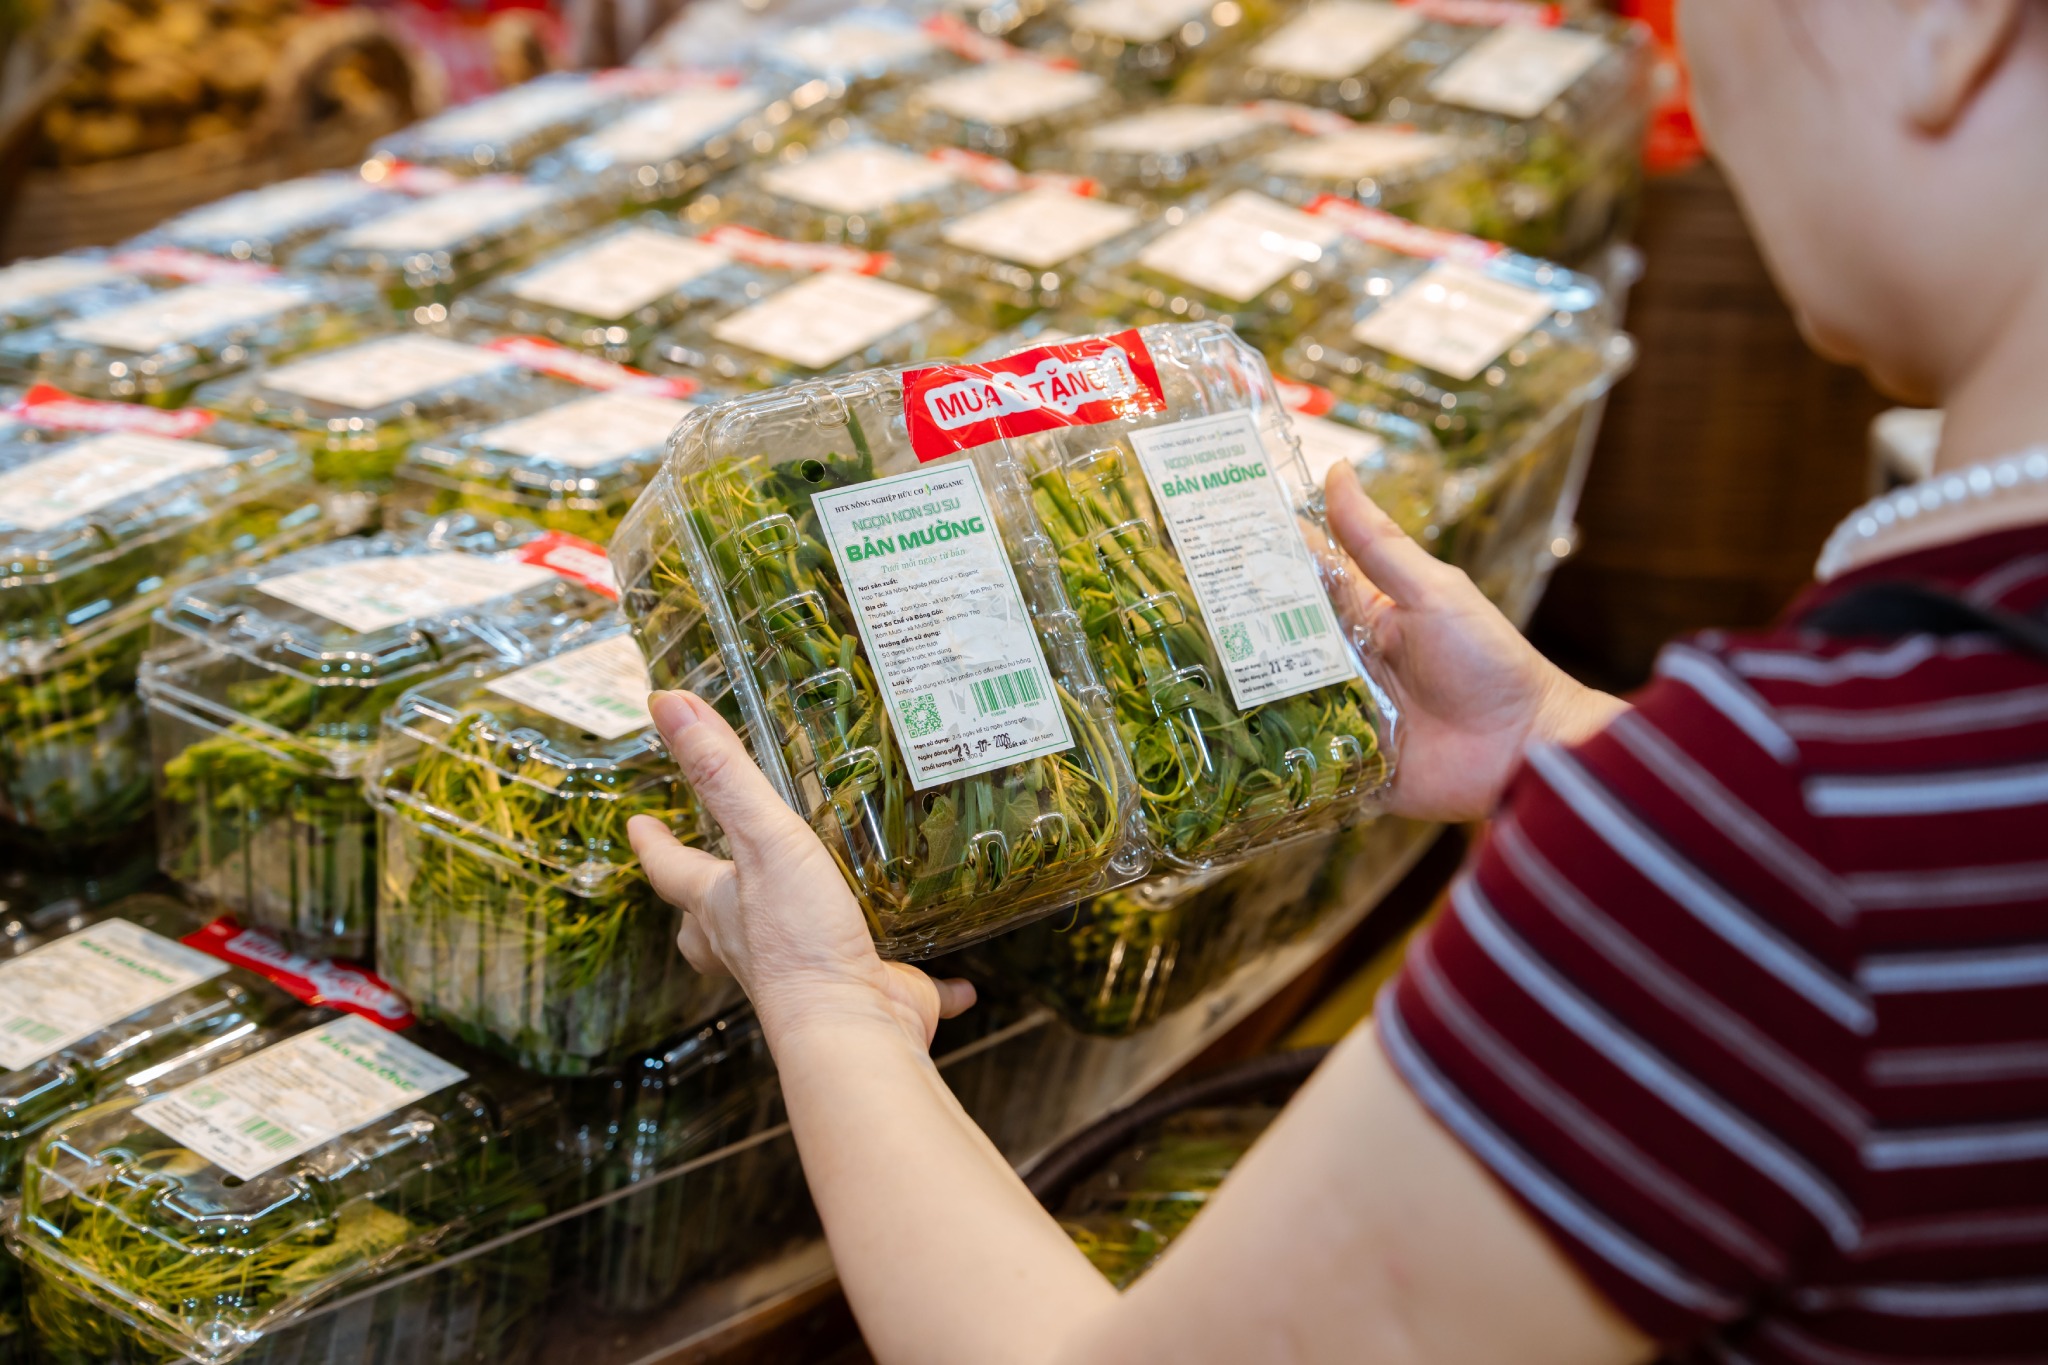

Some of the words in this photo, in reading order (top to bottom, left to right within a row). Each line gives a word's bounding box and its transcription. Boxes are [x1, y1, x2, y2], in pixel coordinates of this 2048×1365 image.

[934, 384, 1003, 421] MUA
[1028, 366, 1107, 406] TẶNG
[1162, 476, 1200, 497] BẢN
[1202, 463, 1266, 489] MƯỜNG
[835, 505, 850, 513] HTX
[850, 501, 870, 509] NÔNG
[871, 494, 896, 504] NGHIỆP
[897, 491, 912, 499] HỮU
[852, 513, 891, 531] NGỌN
[892, 506, 922, 522] NON
[922, 502, 941, 516] SU
[941, 497, 960, 512] SU
[846, 537, 895, 562] BẢN
[898, 517, 984, 550] MƯỜNG
[883, 578, 898, 586] xuất:
[893, 616, 904, 625] Chế
[878, 640, 900, 649] Hướng
[901, 636, 913, 644] dẫn
[921, 763, 935, 772] Khối
[935, 760, 952, 768] lượng
